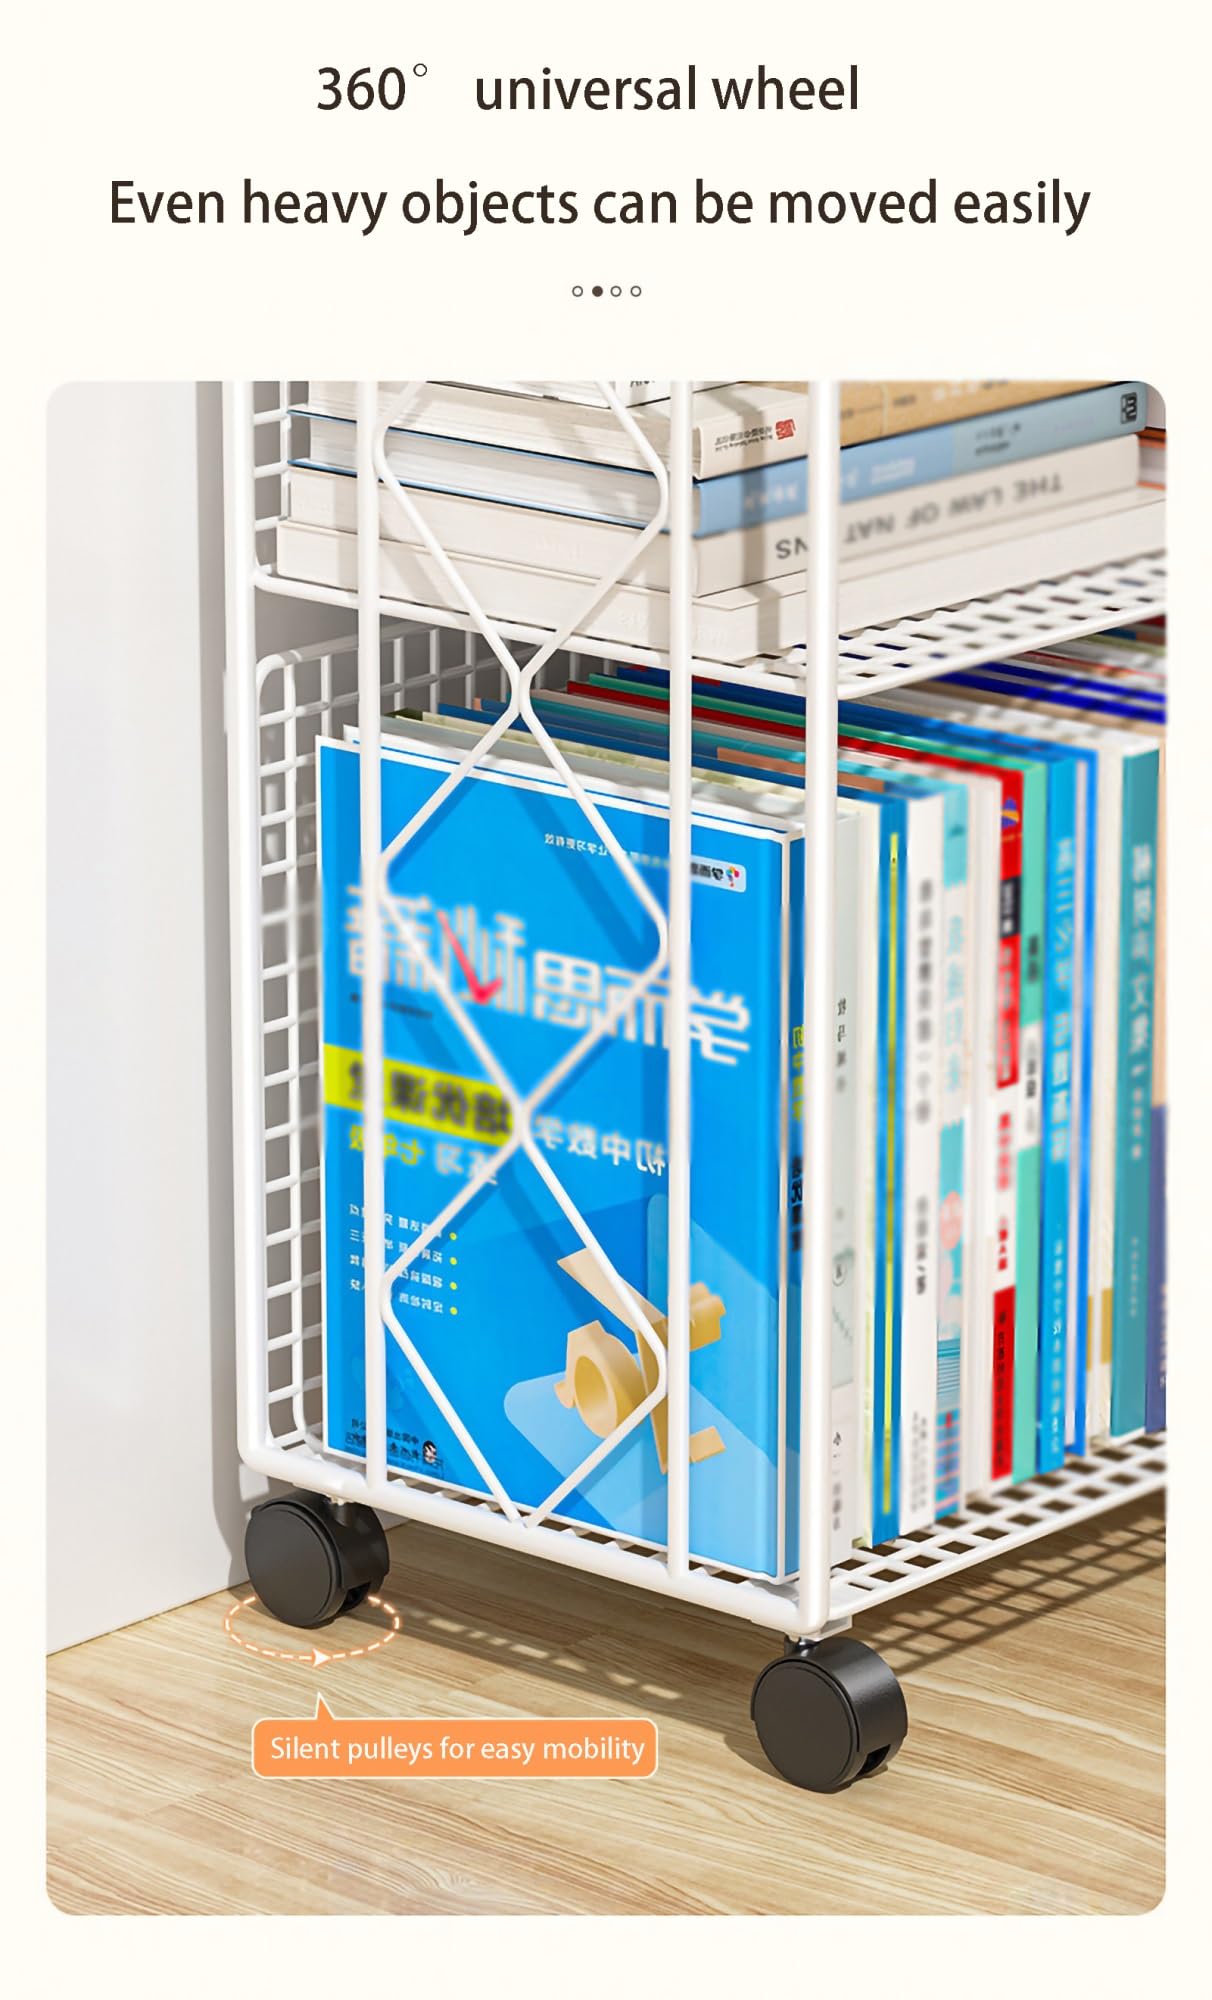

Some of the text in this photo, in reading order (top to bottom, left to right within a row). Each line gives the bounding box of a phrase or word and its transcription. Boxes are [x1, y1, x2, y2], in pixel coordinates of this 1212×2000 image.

[948, 484, 1004, 516] LAW
[1012, 473, 1062, 501] THE
[903, 501, 941, 530] OF
